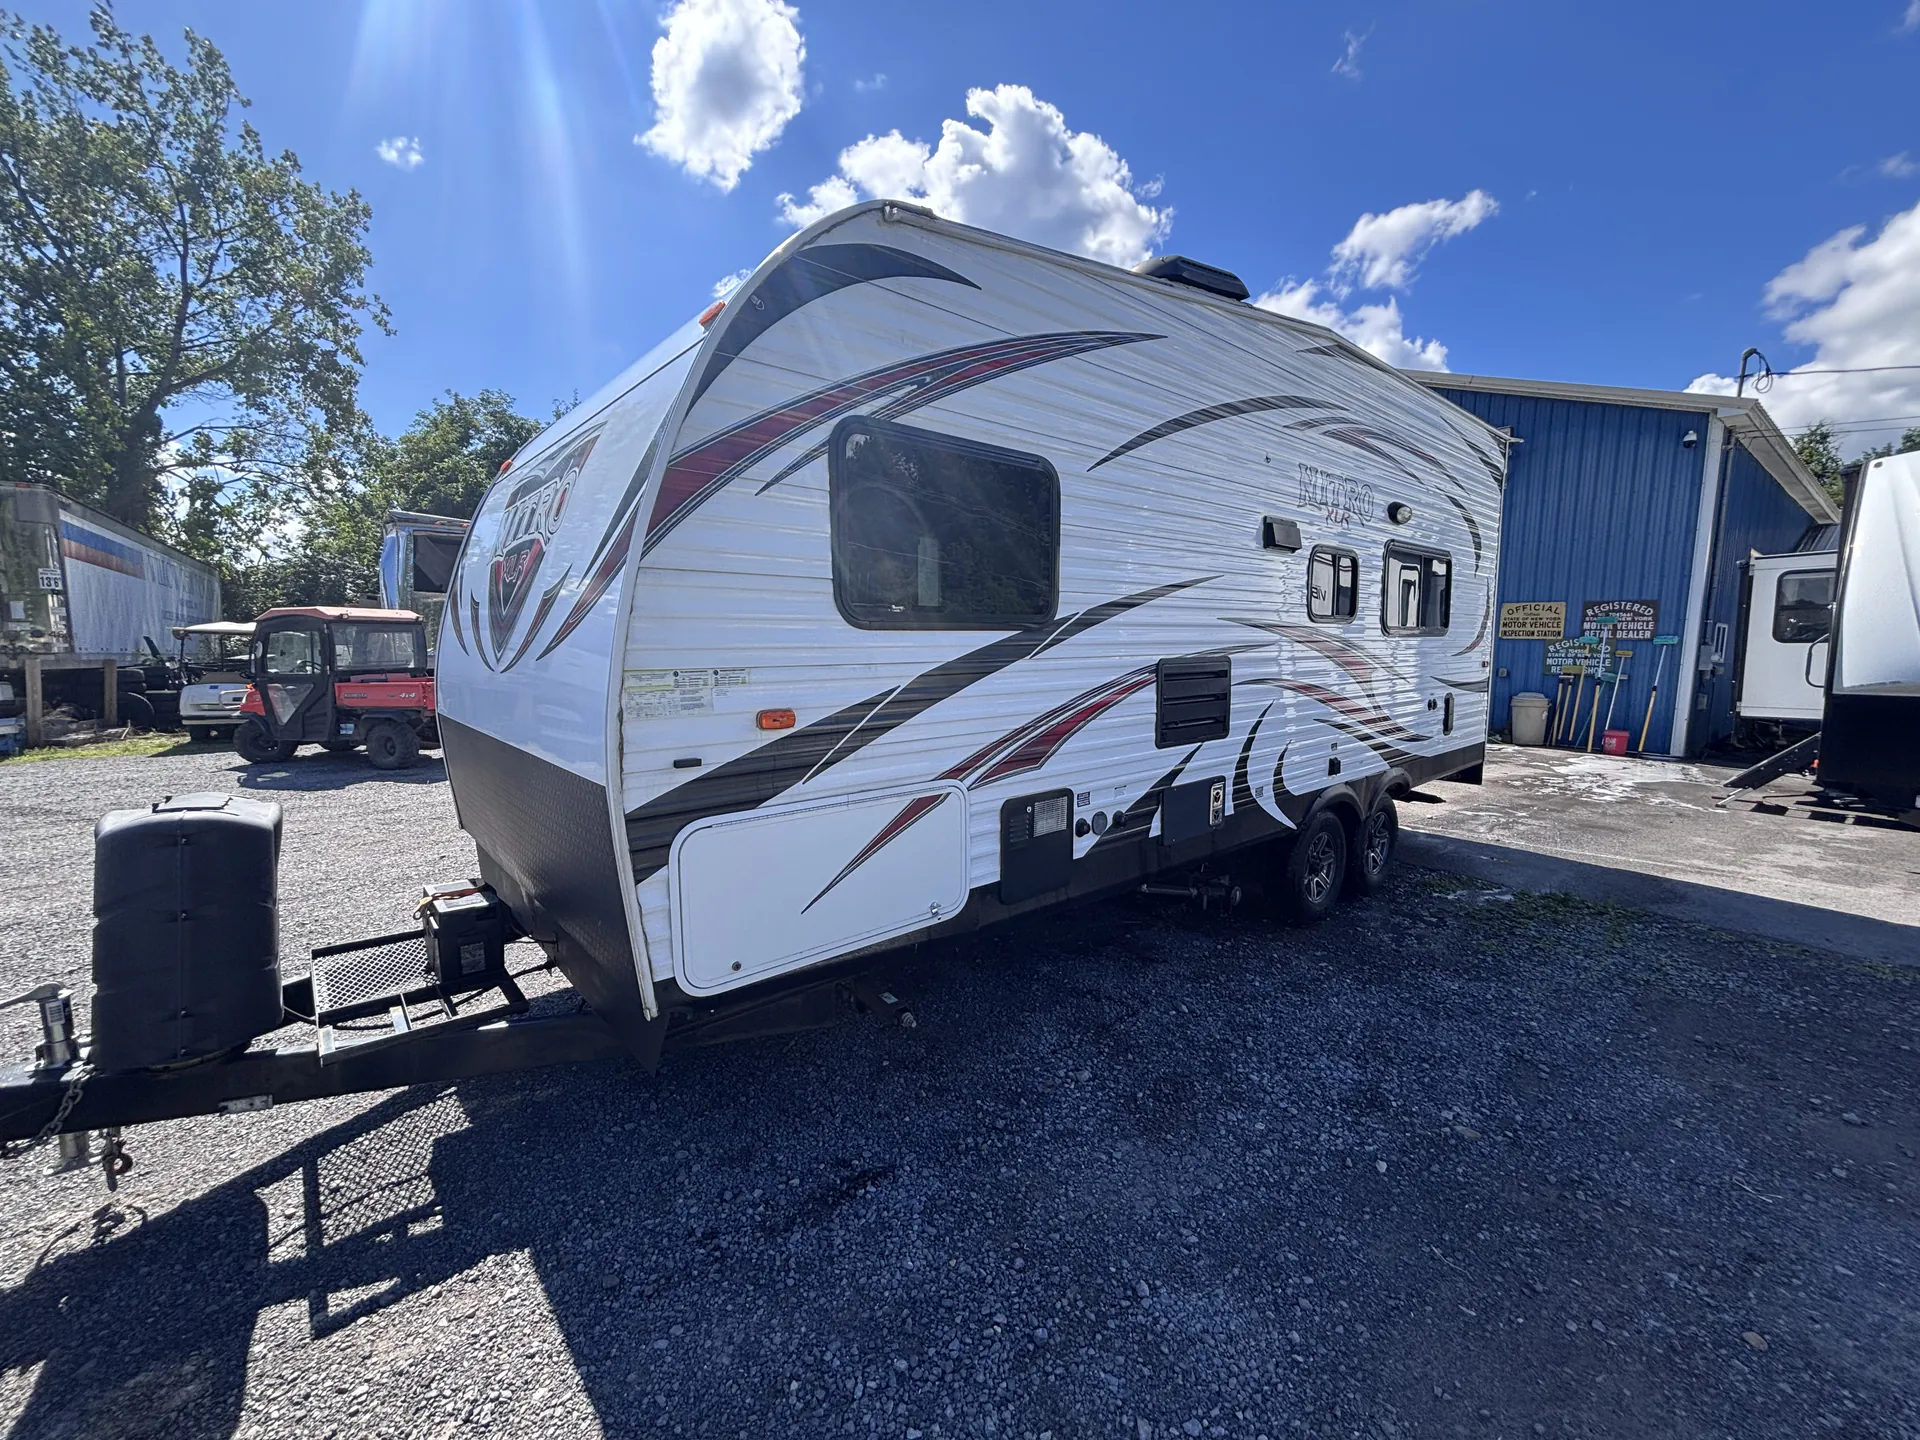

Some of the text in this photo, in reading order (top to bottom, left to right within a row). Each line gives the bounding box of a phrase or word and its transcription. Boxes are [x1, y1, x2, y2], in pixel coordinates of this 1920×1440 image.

[1297, 463, 1374, 526] NITRO
[1326, 508, 1351, 531] XLR
[1507, 603, 1560, 615] OFFICIAL
[1586, 601, 1653, 616] REGISTERED
[1616, 622, 1654, 630] VEHICLE
[1536, 630, 1561, 638] STATION
[1616, 630, 1651, 638] DEALER
